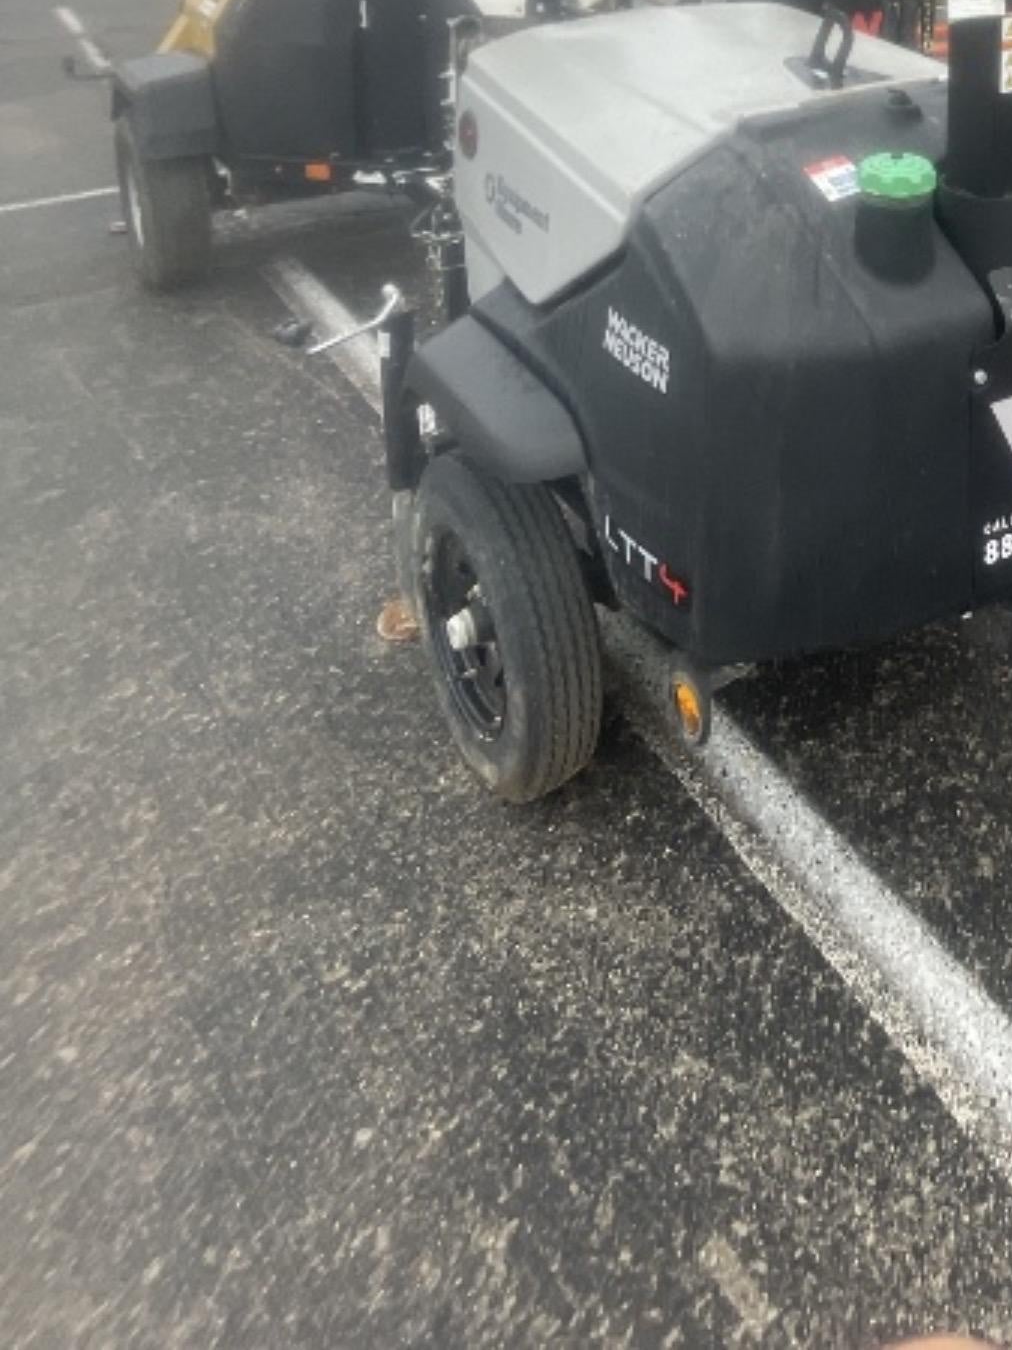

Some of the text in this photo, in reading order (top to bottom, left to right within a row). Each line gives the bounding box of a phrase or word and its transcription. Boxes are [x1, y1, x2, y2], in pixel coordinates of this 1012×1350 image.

[602, 329, 669, 394] NEUSON
[607, 305, 670, 373] WACKER
[604, 514, 689, 606] LTT4
